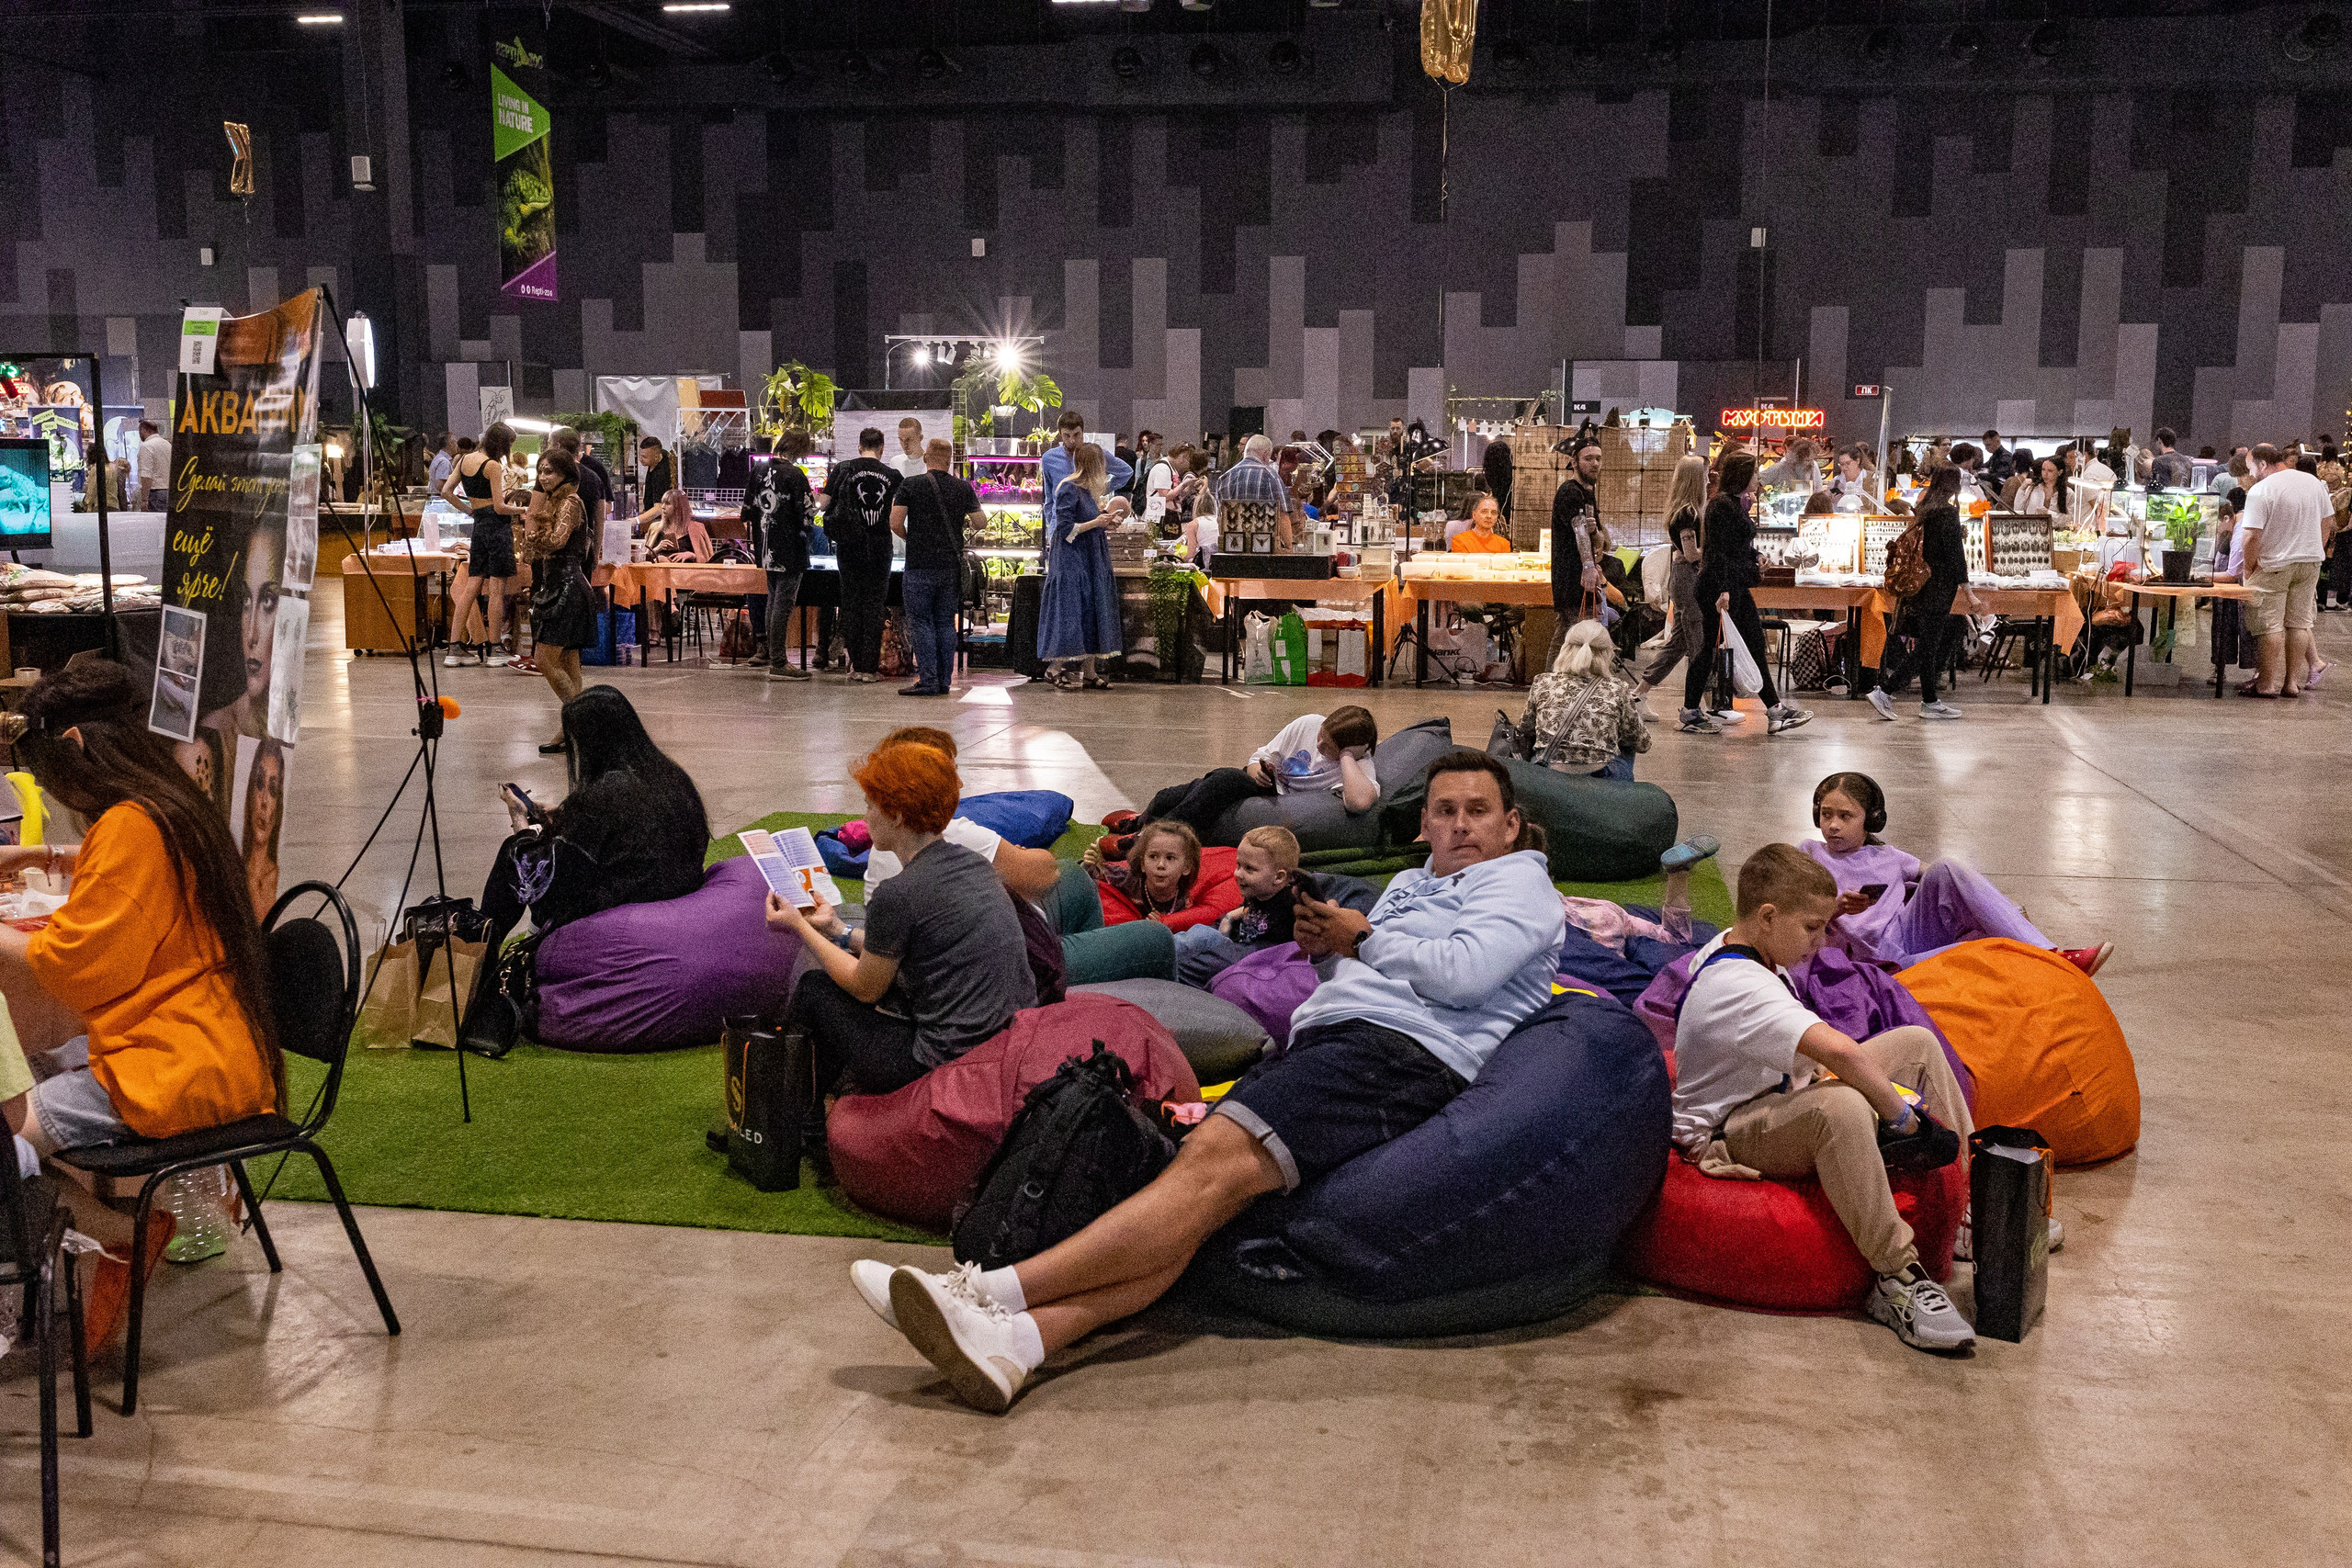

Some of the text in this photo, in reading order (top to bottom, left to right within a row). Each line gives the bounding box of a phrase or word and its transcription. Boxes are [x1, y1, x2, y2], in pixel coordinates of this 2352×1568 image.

[498, 92, 529, 115] LIVING IN
[499, 107, 534, 134] NATURE
[1860, 386, 1872, 394] ПК
[175, 456, 229, 513] Сделай
[231, 476, 262, 494] этот
[173, 525, 215, 567] ещё
[176, 551, 239, 608] ярче!
